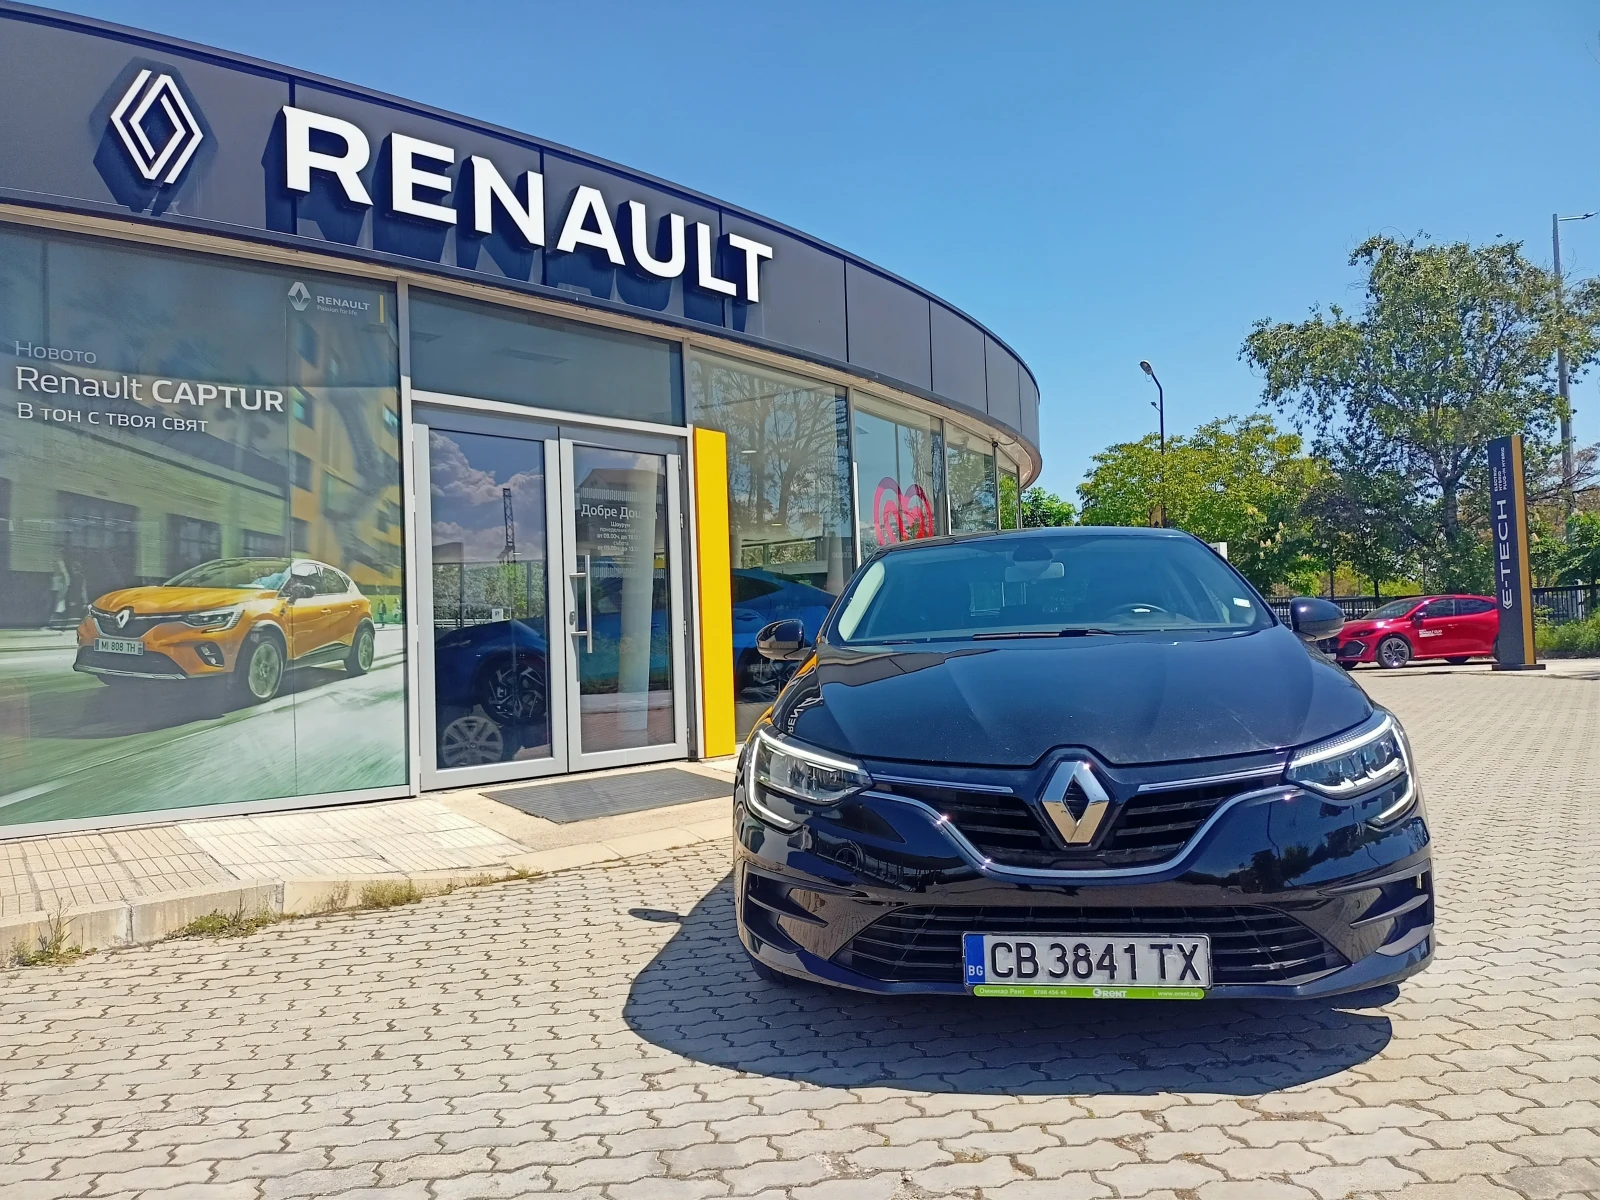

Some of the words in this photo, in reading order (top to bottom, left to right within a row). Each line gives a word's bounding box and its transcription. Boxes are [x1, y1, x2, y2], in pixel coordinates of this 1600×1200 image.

[282, 105, 773, 303] RENAULT
[317, 295, 370, 311] RENAULT
[317, 305, 338, 313] Passion
[15, 340, 97, 364] Новото
[16, 366, 143, 401] Renault
[151, 379, 284, 412] CAPTUR
[17, 402, 33, 419] В
[40, 407, 81, 423] тон
[88, 411, 100, 425] с
[105, 412, 156, 429] твоя
[162, 417, 208, 433] свят
[580, 503, 617, 519] Добре
[619, 506, 658, 520] Дош
[1496, 499, 1513, 610] E-TECH
[101, 641, 109, 649] MI
[111, 642, 124, 651] 808
[126, 642, 136, 652] TH
[968, 964, 984, 976] BG
[990, 942, 1040, 979] CB
[1048, 942, 1139, 980] 3841
[1150, 942, 1202, 981] TX
[979, 987, 1008, 996] Омникар
